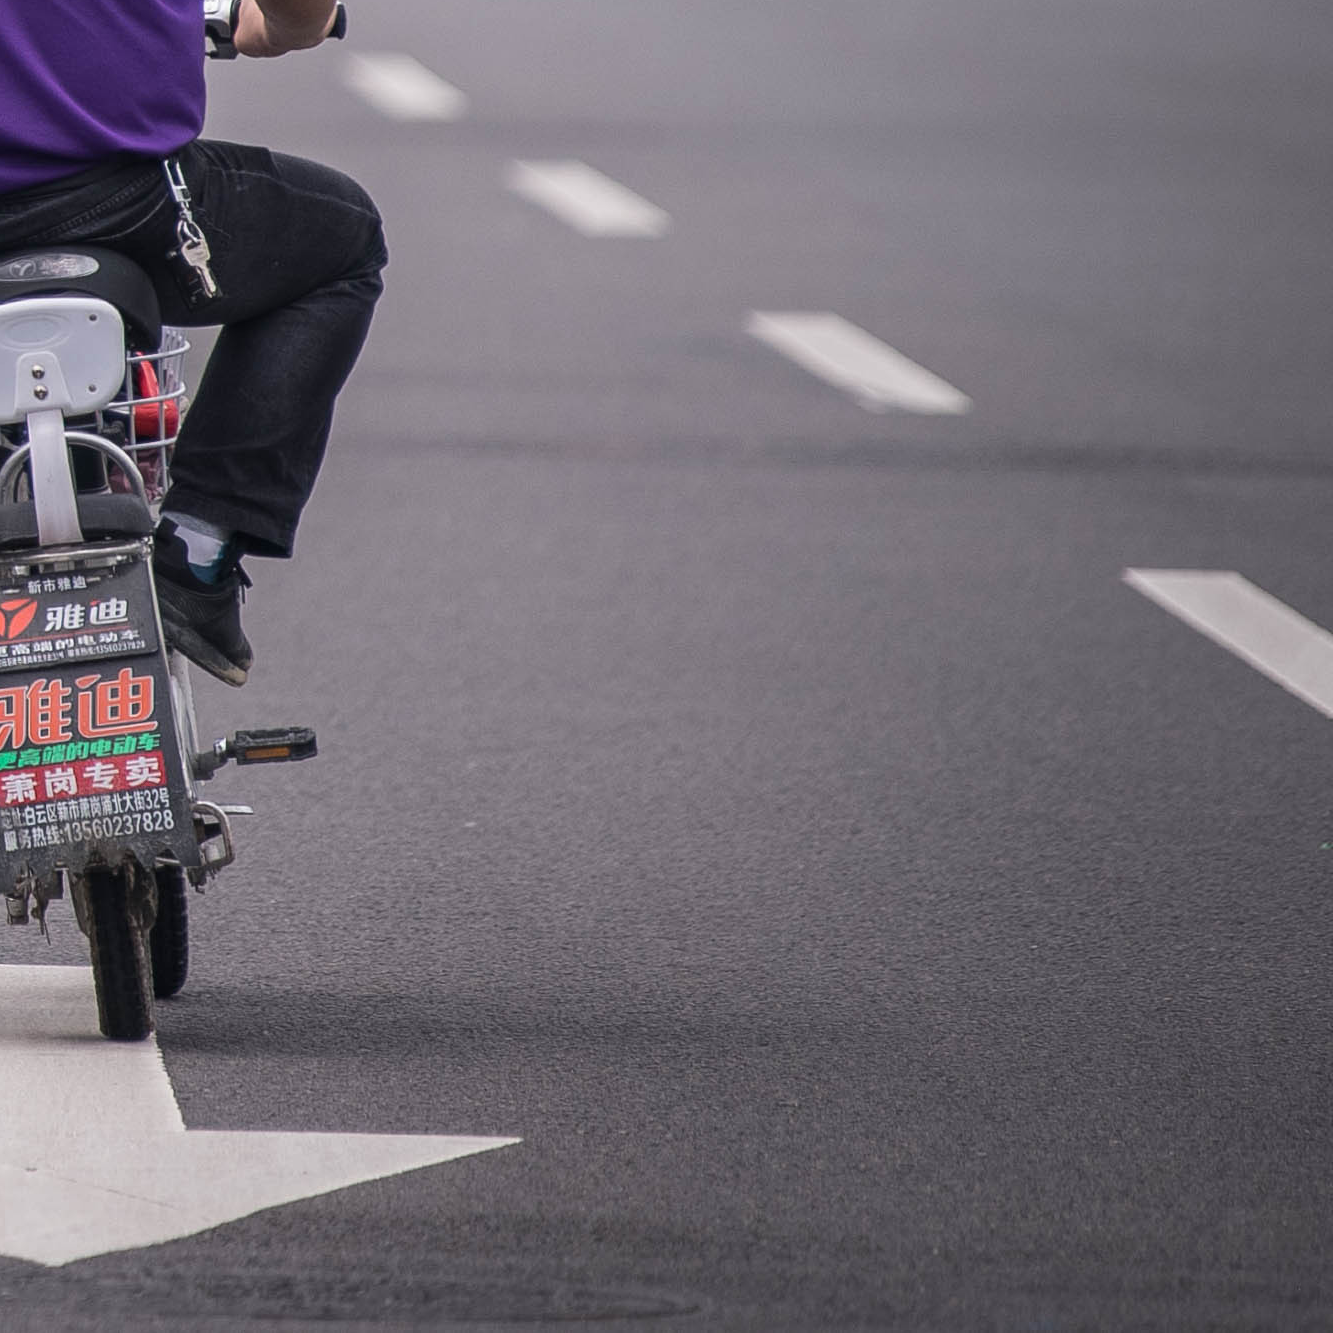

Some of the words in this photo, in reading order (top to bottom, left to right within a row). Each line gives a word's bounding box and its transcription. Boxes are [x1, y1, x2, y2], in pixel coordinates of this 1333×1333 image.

[44, 597, 130, 633] 雅迪
[0, 755, 163, 805] 萧岗专卖
